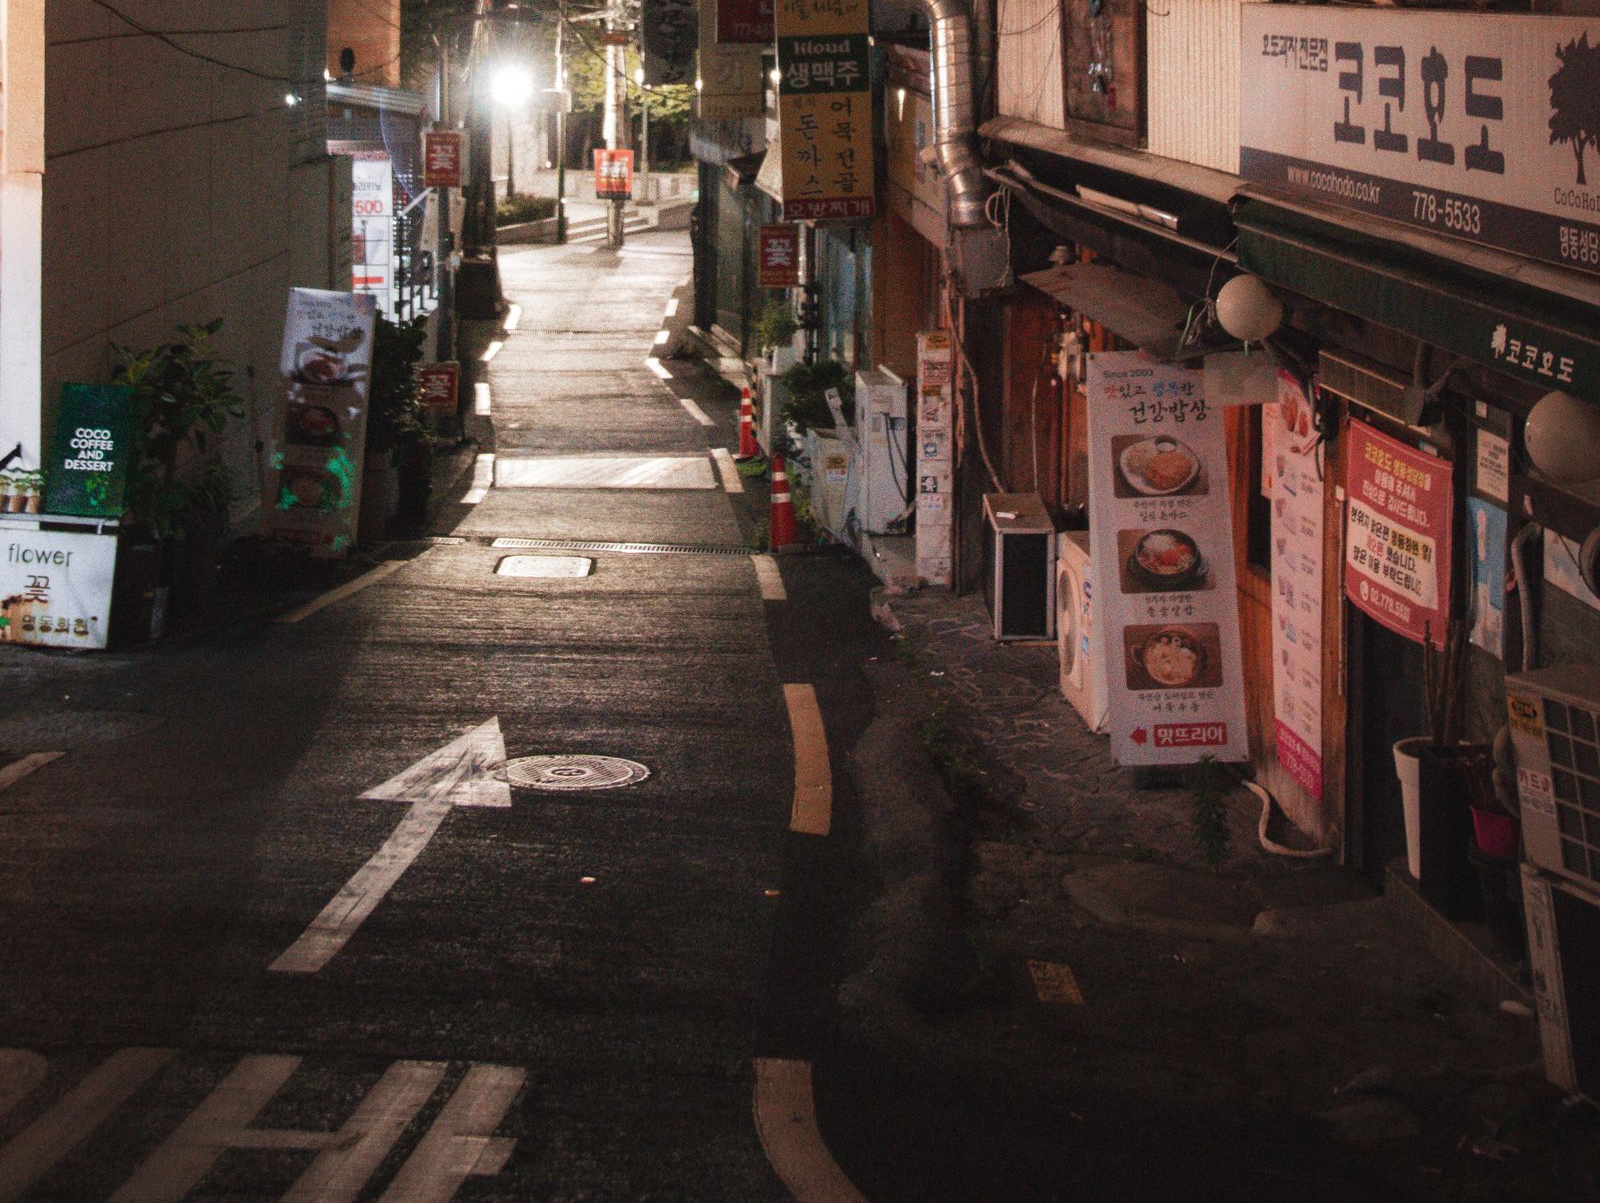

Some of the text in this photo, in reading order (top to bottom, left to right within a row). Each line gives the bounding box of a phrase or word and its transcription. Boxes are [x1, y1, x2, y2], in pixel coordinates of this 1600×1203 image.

[793, 39, 851, 55] Kloud
[786, 60, 861, 88] 생맥주
[1334, 42, 1505, 175] 코코호도
[795, 113, 823, 196] 돈까스
[1412, 191, 1481, 235] 778-5533
[765, 238, 792, 267] 꽃
[1506, 339, 1575, 383] 코코호도
[1104, 381, 1147, 399] 맛있고
[1129, 399, 1211, 424] 건강밥상
[70, 438, 114, 451] COFFEE
[75, 428, 111, 440] COCO
[64, 458, 114, 472] DESSERT
[78, 450, 104, 460] AND
[8, 543, 74, 567] flower
[24, 574, 51, 603] 꽃
[1157, 726, 1224, 745] 맛뜨리아
